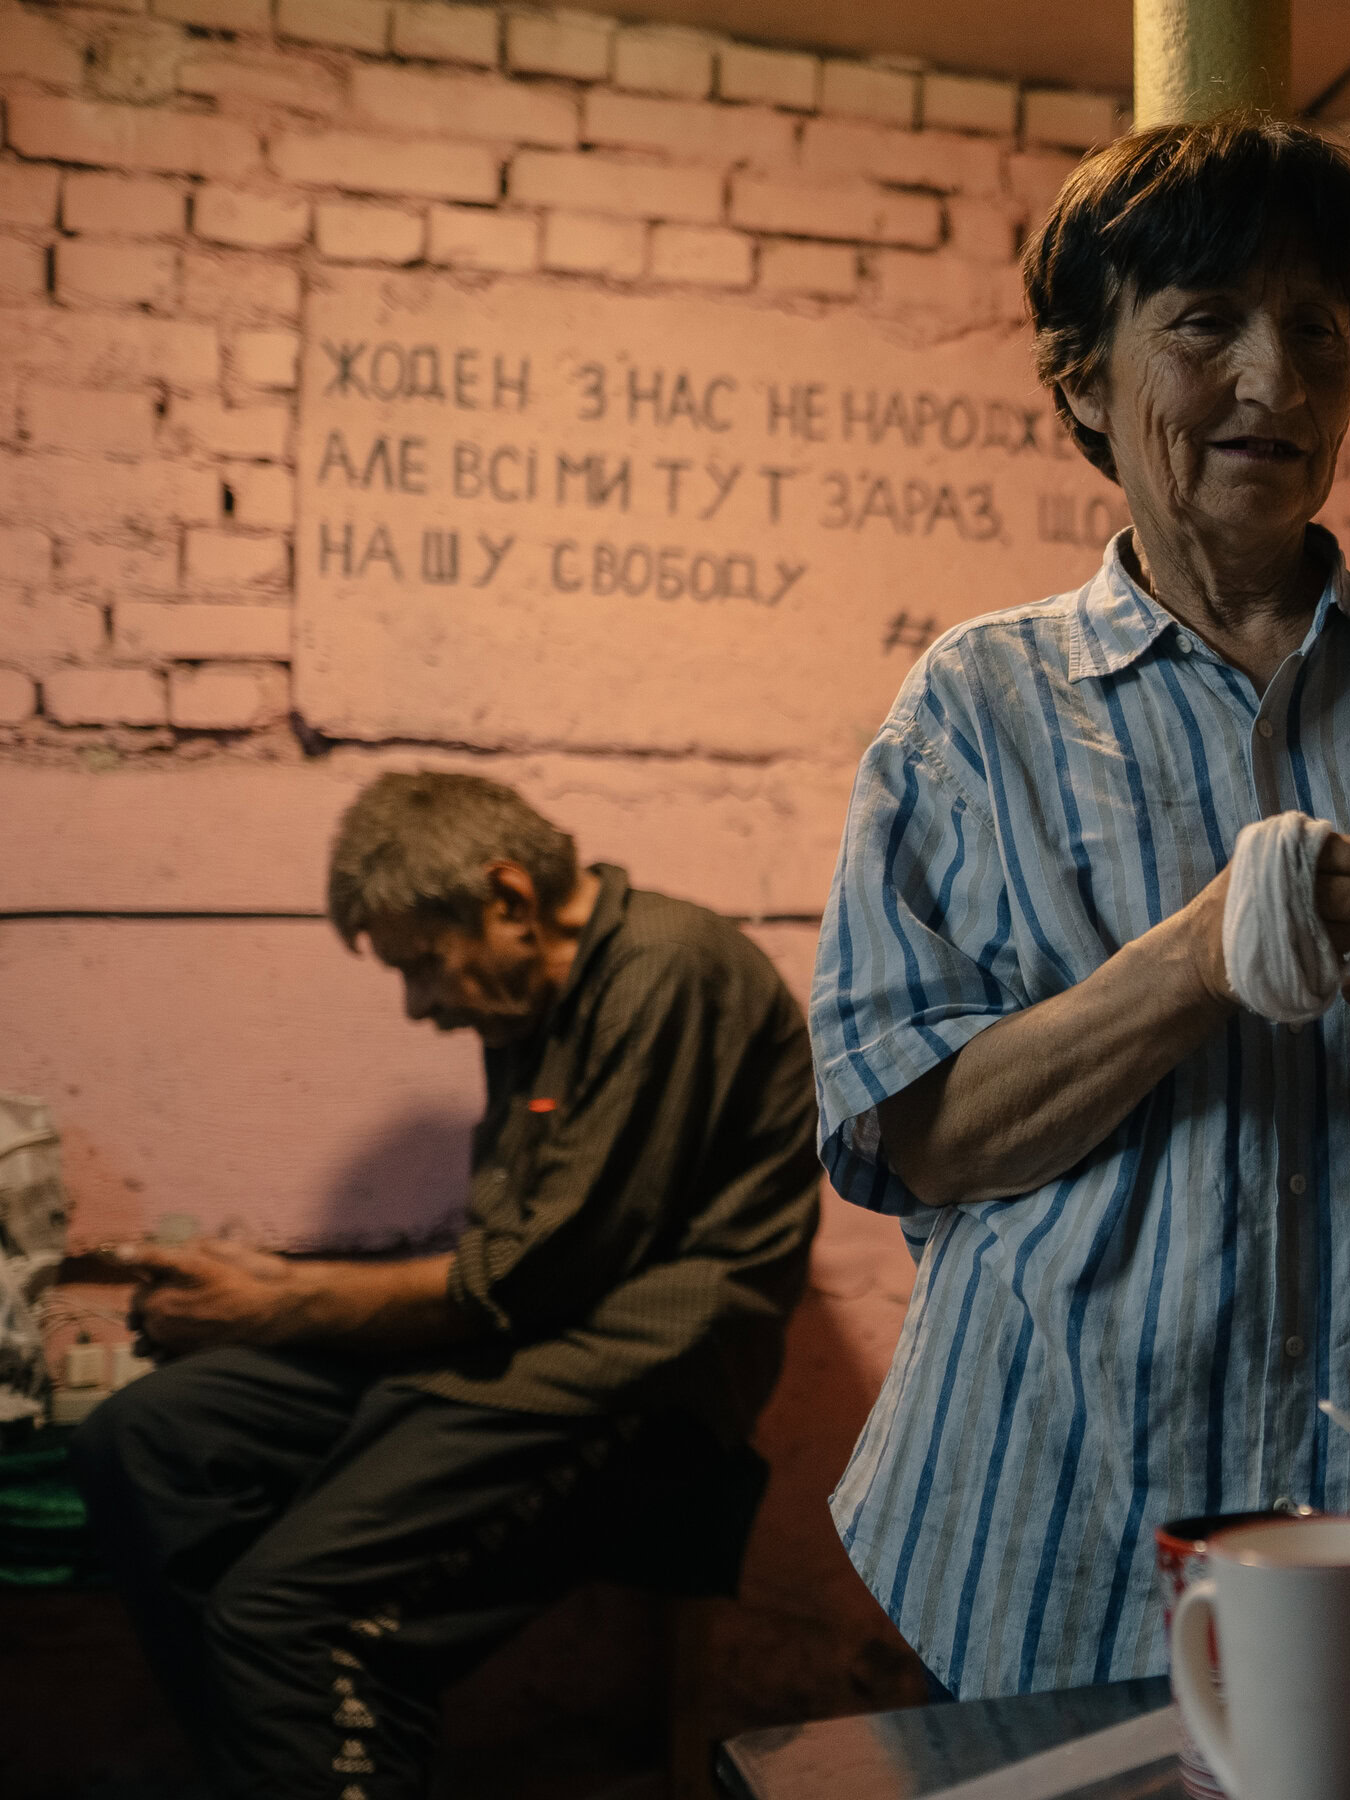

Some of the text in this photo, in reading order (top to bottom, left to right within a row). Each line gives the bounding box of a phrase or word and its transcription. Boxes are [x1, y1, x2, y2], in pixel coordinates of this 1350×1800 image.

[321, 338, 532, 414] ЖОДЕН
[767, 381, 828, 442] НЕ
[316, 427, 428, 497] АЛЕ
[452, 439, 537, 502] ВСІ
[555, 450, 632, 513] МИ
[653, 456, 811, 526] ТУТ
[318, 520, 809, 608] НАШУ СВОБОДУ
